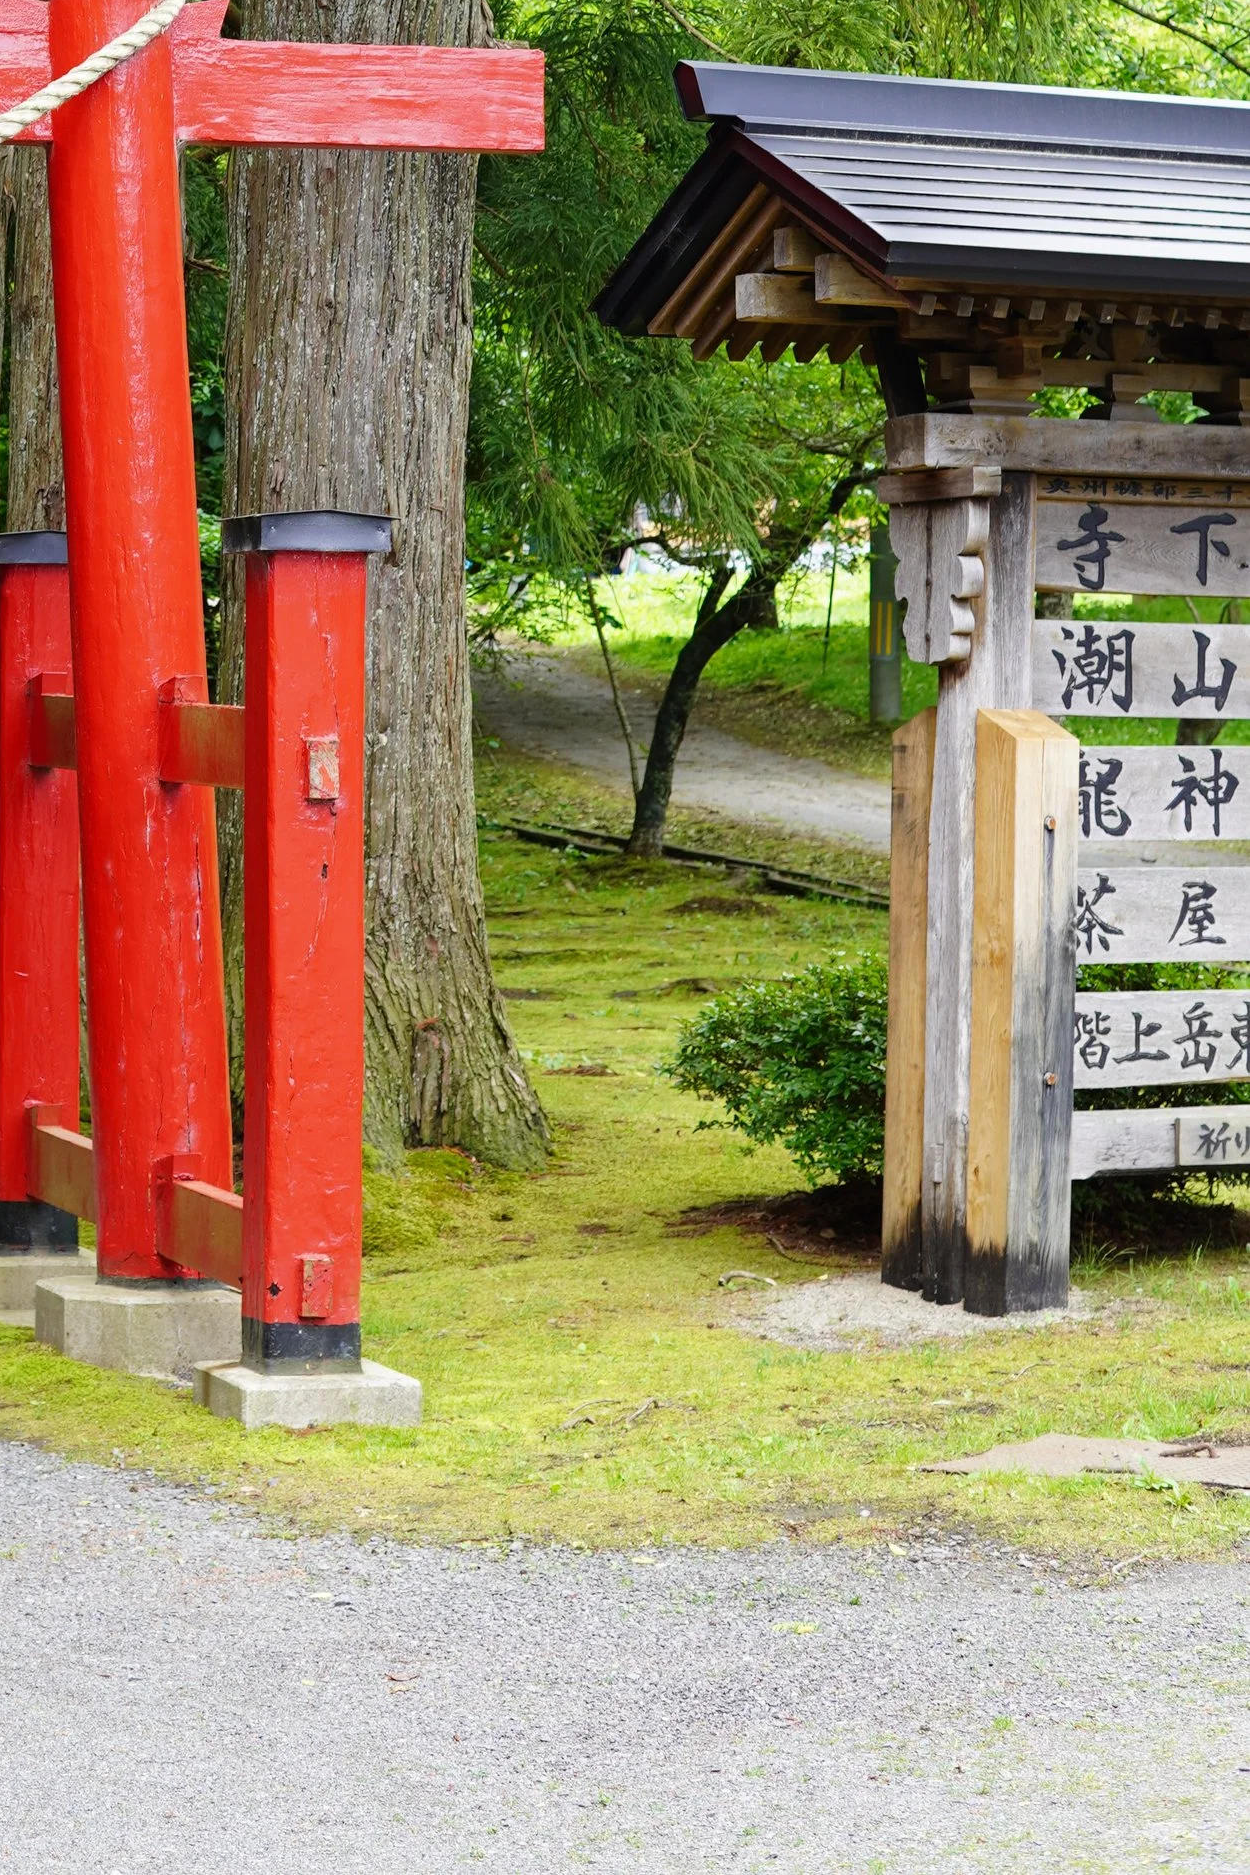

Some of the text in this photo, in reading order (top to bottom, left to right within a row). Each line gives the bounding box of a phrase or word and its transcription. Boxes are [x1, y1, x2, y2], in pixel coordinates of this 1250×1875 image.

[1042, 477, 1250, 502] 奥州糠部三十
[1057, 501, 1237, 590] 寺下
[1052, 625, 1237, 713] 潮山
[1079, 749, 1240, 838] 龍神
[1076, 872, 1227, 955] 茶屋
[1192, 1121, 1250, 1160] 祈り
